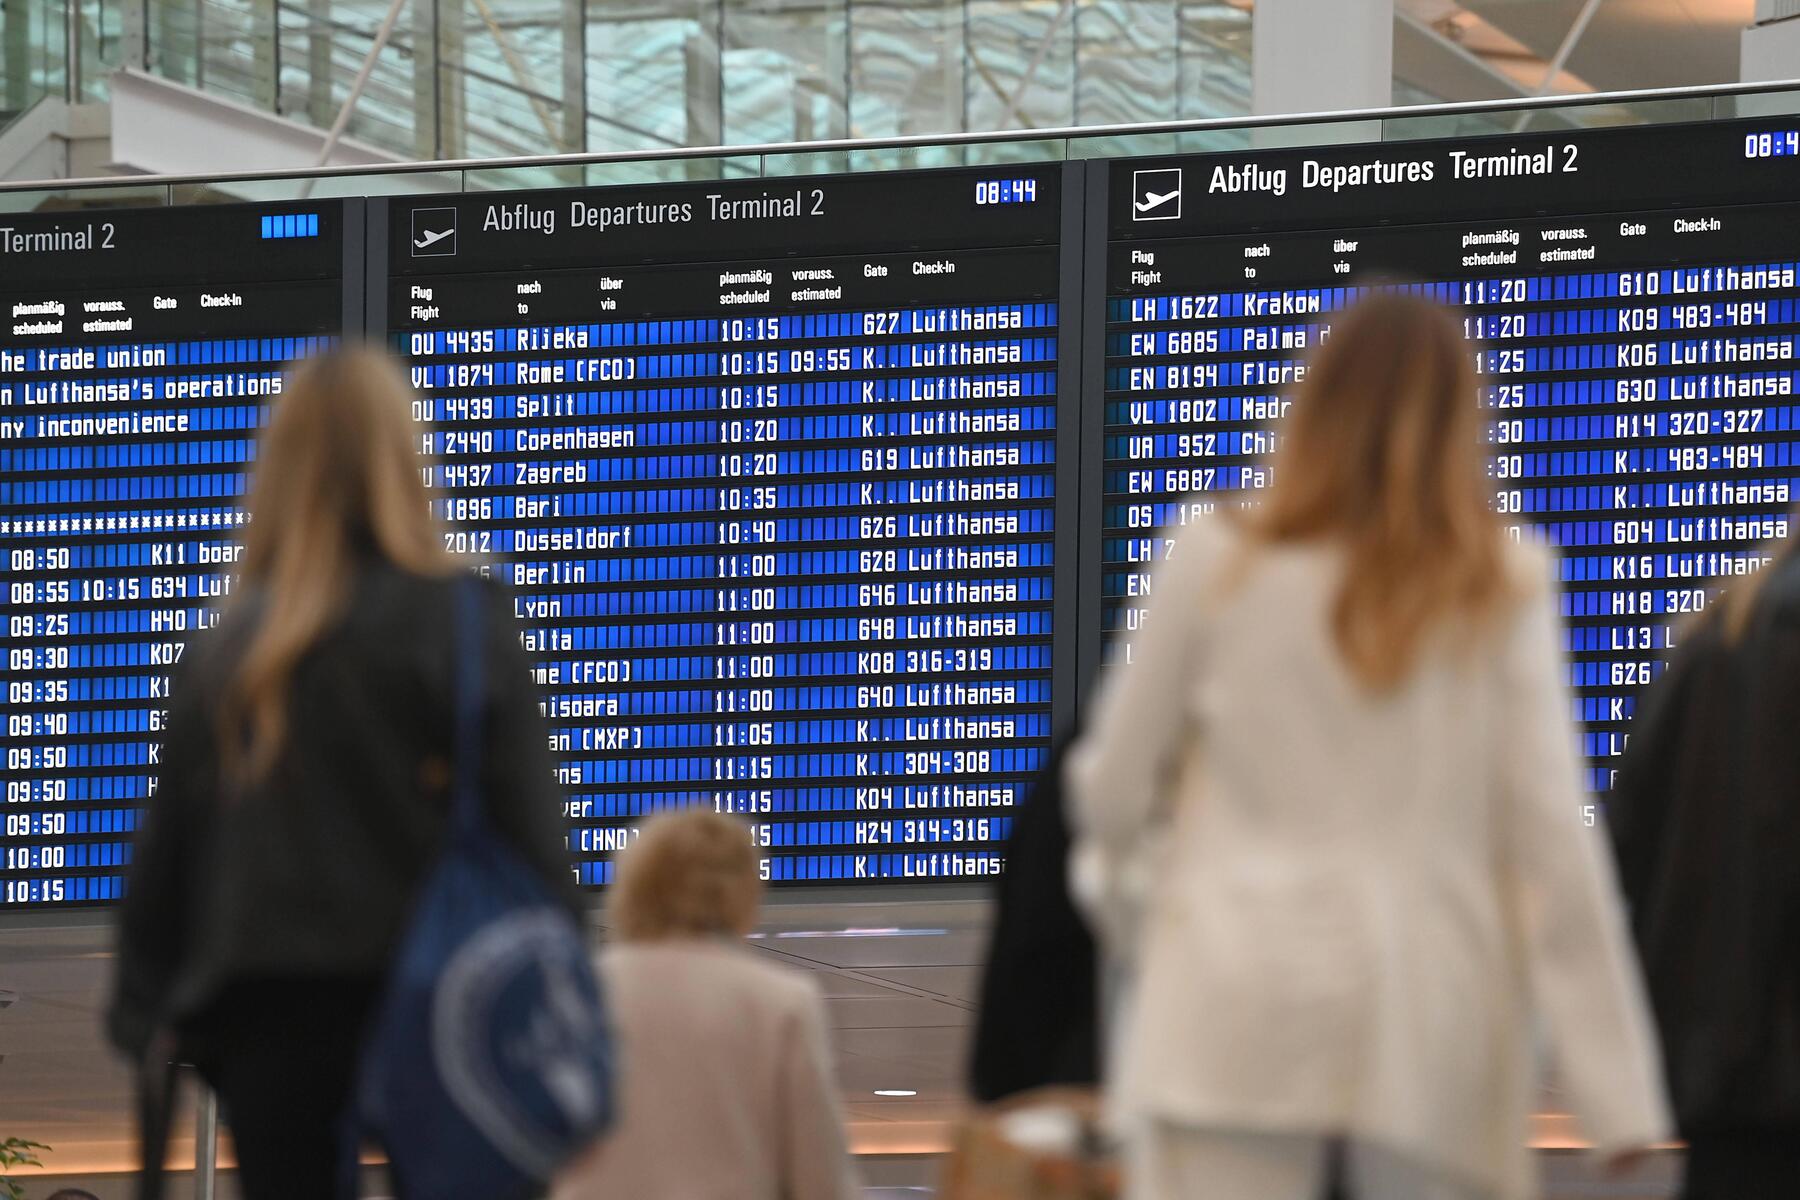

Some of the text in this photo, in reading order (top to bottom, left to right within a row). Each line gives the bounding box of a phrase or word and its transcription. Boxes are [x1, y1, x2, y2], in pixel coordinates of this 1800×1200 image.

[1208, 145, 1577, 195] Abflug Departures Terminal 2
[975, 181, 1035, 204] 08:44
[483, 190, 823, 234] Abflug Departures Terminal 2
[0, 224, 114, 252] Terminal 2
[1131, 218, 1720, 265] Flug nach über planmäßig vorauss. Gate Check-In
[1131, 246, 1594, 286] Flight to via scheduled estimated
[411, 261, 954, 301] Flug nach über planmäßig vorauss. Gate Check-In
[1131, 268, 1793, 321] LH 1622 Krakow 11:20 Lufthansa
[12, 294, 241, 317] planmäßig vorauss. Gate Check-In
[411, 286, 841, 321] Flight to via scheduled estimated
[12, 318, 132, 335] scheduled estimated
[446, 331, 493, 353] 4435
[517, 328, 587, 350] Rijeka
[722, 319, 778, 341] 10:15
[912, 310, 1020, 333] Lufthansa
[1131, 303, 1765, 356] EW 6885 Palma 11:20 K09 483-484
[38, 346, 164, 370] trade union
[411, 367, 433, 388] VL
[448, 365, 492, 387] 1874
[517, 363, 563, 384] Rome
[721, 352, 777, 375] 10:15
[790, 349, 850, 372] 09:55
[911, 344, 1020, 367] Lufthansa
[1130, 340, 1791, 390] EN 8194 K06 Lufthansa
[165, 375, 281, 398] operations
[446, 378, 1019, 420] 4439 Split 10:15 Lufthansa
[1130, 376, 1790, 424] VL 1802 Lufthansa
[38, 413, 188, 437] inconvenience
[445, 412, 1019, 454] 2440 Copenhagen 10:20 Lufthansa
[1129, 410, 1763, 459] UA 952 H14 320-327
[445, 446, 1018, 487] 4437 Zagreb 10:20 Lufthansa
[1128, 445, 1762, 493] EW 6887 483-484
[446, 480, 1018, 520] 1896 Bari 10:35 Lufthansa
[1668, 483, 1788, 506] Lufthansa
[514, 514, 1017, 551] Dusseldorf 10:40 Lufthansa
[1127, 518, 1787, 562] LH Lufthansa
[11, 544, 184, 570] 08:50 K11
[514, 563, 584, 585] Berlin
[718, 555, 774, 577] 11:00
[908, 548, 1016, 570] Lufthansa
[1127, 556, 1652, 596] EN K16
[11, 578, 139, 603] 08:55 10:15
[514, 582, 1016, 618] Lyon 11:00 Lufthansa
[1612, 592, 1651, 614] H18
[10, 610, 185, 637] 09:25 H40
[717, 616, 1015, 645] 11:00 Lufthansa
[1611, 628, 1650, 649] L13
[10, 643, 184, 670] 09:30 K07
[716, 657, 773, 678] 11:00
[858, 653, 893, 674] K08
[906, 649, 991, 672] 316-319
[9, 681, 67, 703] 09:35
[716, 684, 1014, 712] 11:00 Lufthansa
[9, 714, 66, 736] 09:40
[715, 724, 771, 746] 11:05
[905, 718, 1014, 740] Lufthansa
[8, 747, 66, 769] 09:50
[715, 751, 989, 779] 11:15 304-308
[7, 780, 65, 802] 09:50
[714, 786, 1013, 813] 11:15 K04 Lufthansa
[6, 813, 64, 835] 09:50
[855, 820, 988, 843] H24 314-316
[8, 847, 64, 869] 10:00
[7, 880, 63, 902] 10:15
